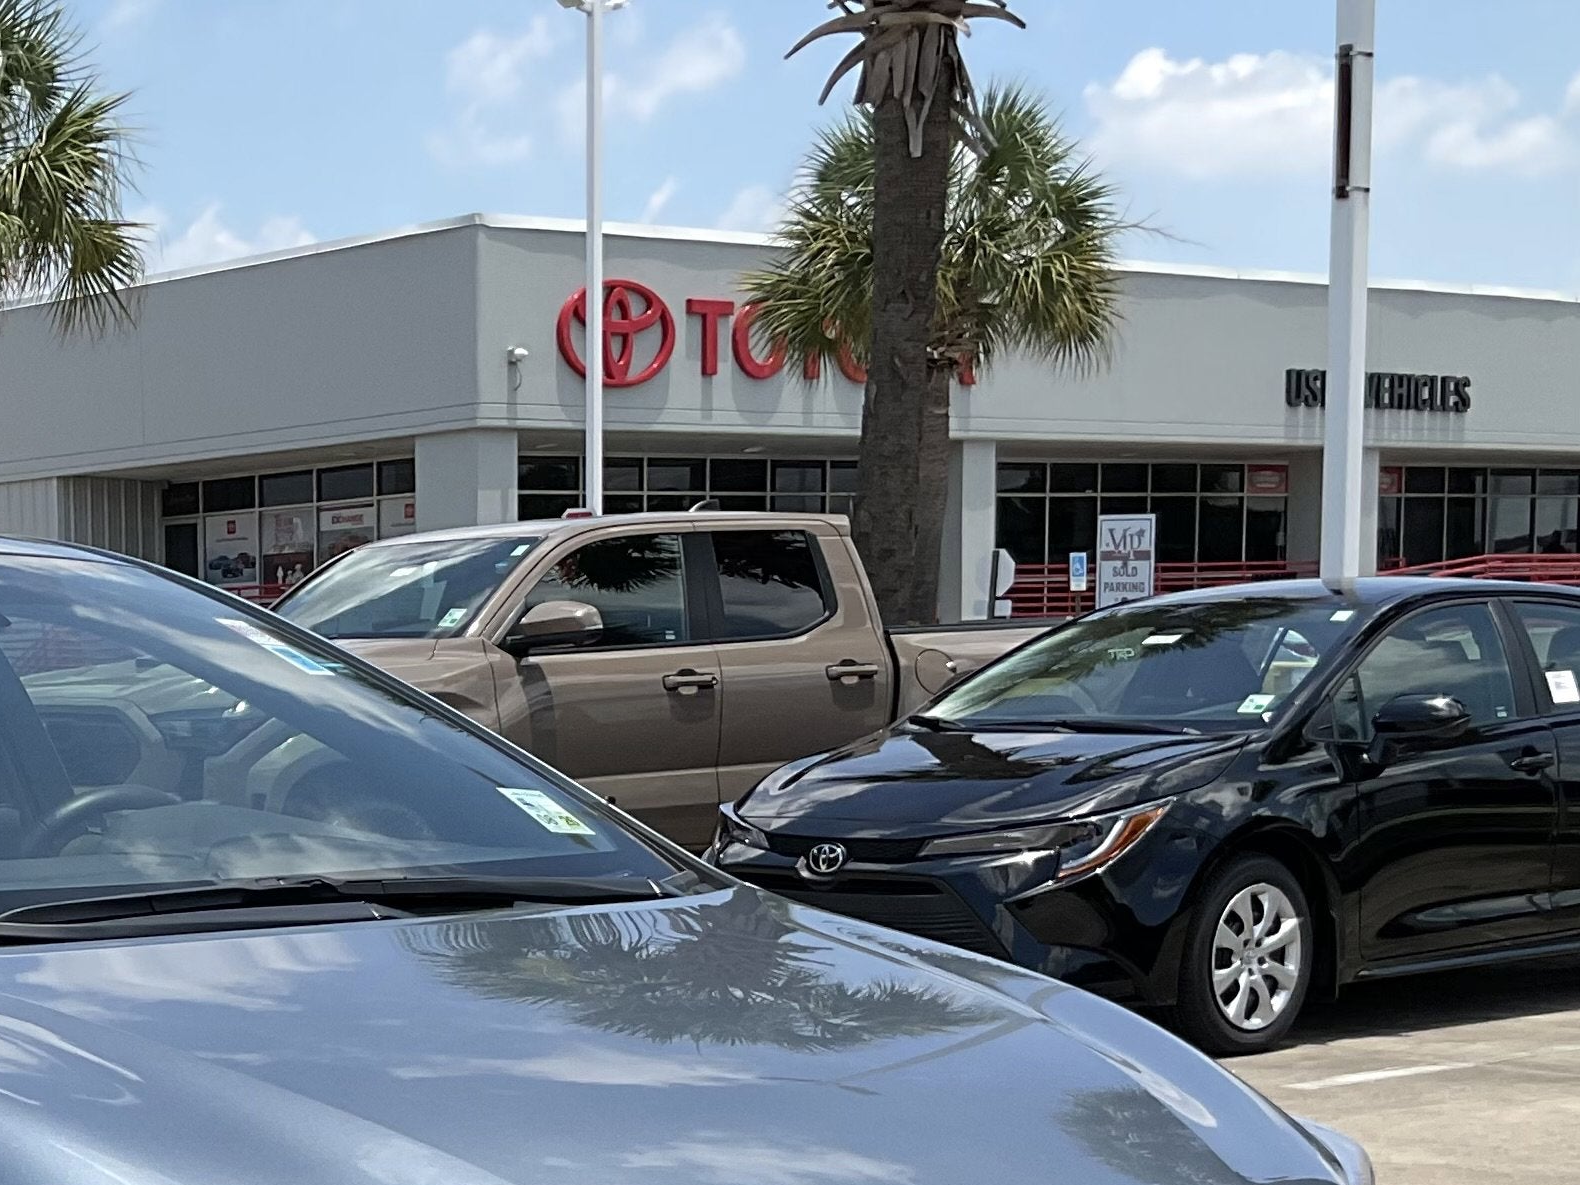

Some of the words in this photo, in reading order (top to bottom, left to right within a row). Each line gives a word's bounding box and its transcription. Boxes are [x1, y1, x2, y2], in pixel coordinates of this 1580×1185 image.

[1286, 368, 1327, 409] US
[1364, 372, 1471, 412] VEHICLES
[1112, 565, 1138, 577] SOLD
[1103, 581, 1146, 593] PARKING
